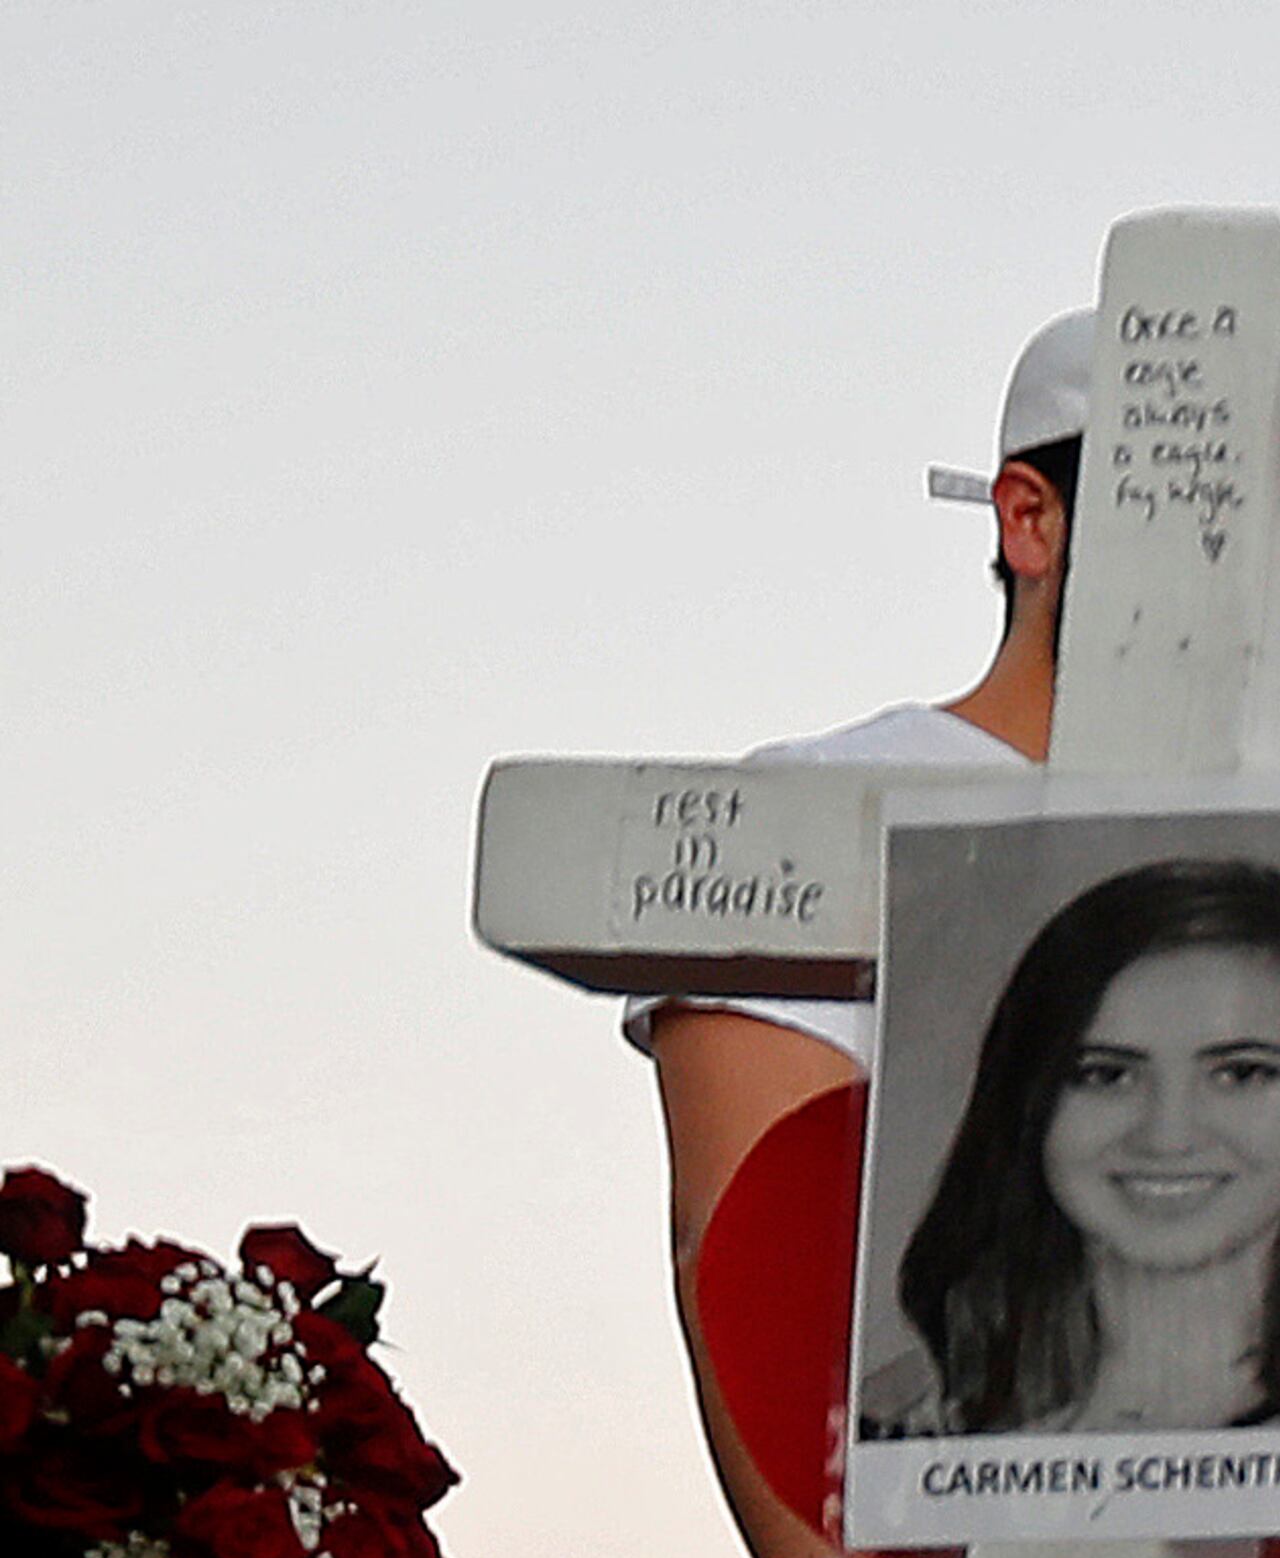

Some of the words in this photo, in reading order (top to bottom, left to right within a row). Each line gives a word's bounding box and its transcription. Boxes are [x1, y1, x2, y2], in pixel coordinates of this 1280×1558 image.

[654, 788, 743, 828] rest
[673, 833, 718, 870] in
[633, 857, 824, 923] paradise
[922, 1458, 1099, 1496] CARMEN
